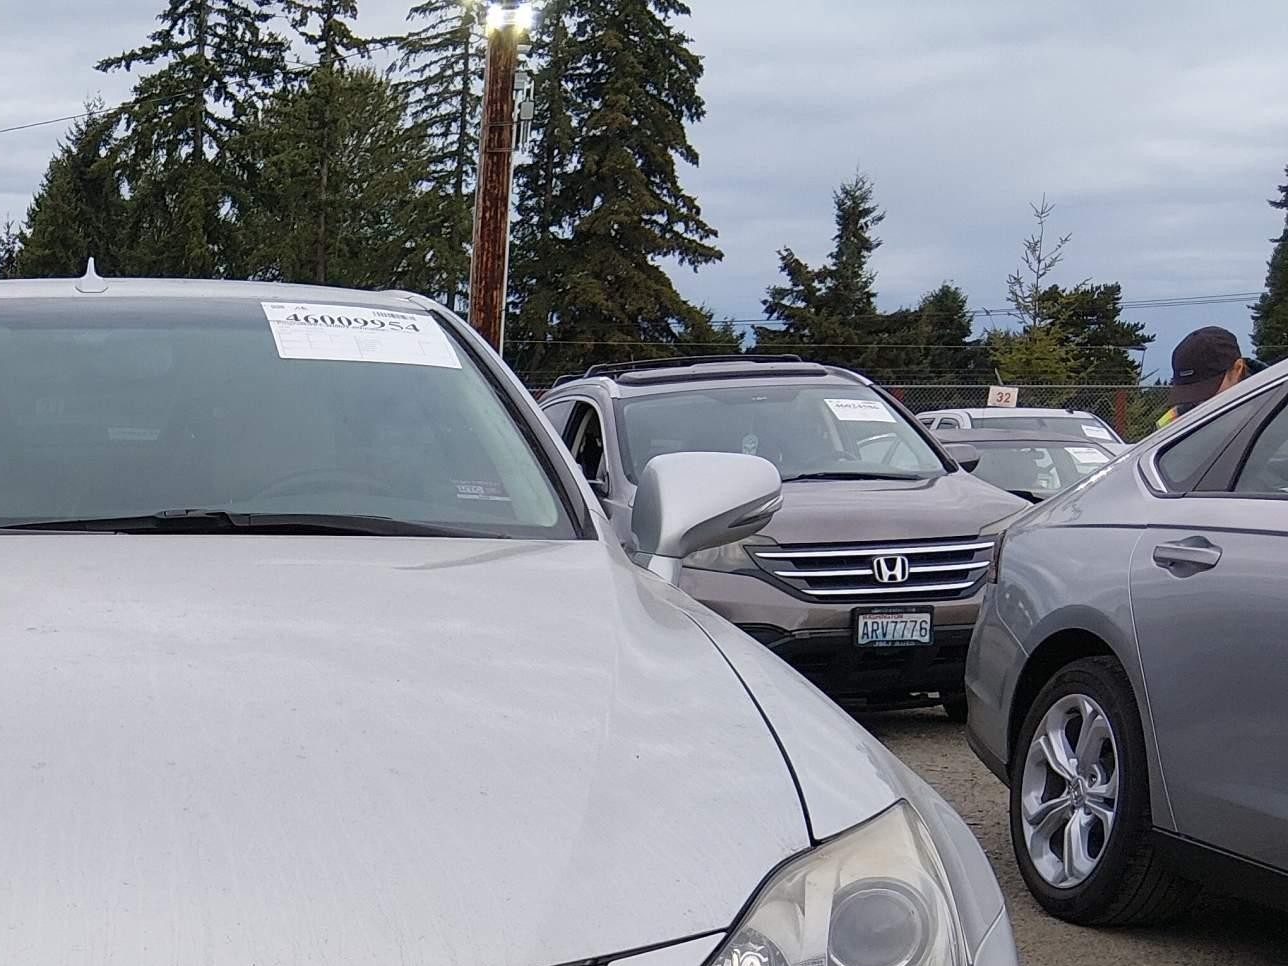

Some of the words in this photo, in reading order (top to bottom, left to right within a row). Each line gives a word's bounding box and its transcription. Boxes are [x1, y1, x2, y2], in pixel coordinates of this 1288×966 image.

[286, 313, 420, 333] 46009954
[996, 391, 1011, 403] 32
[861, 620, 929, 640] ARV7776
